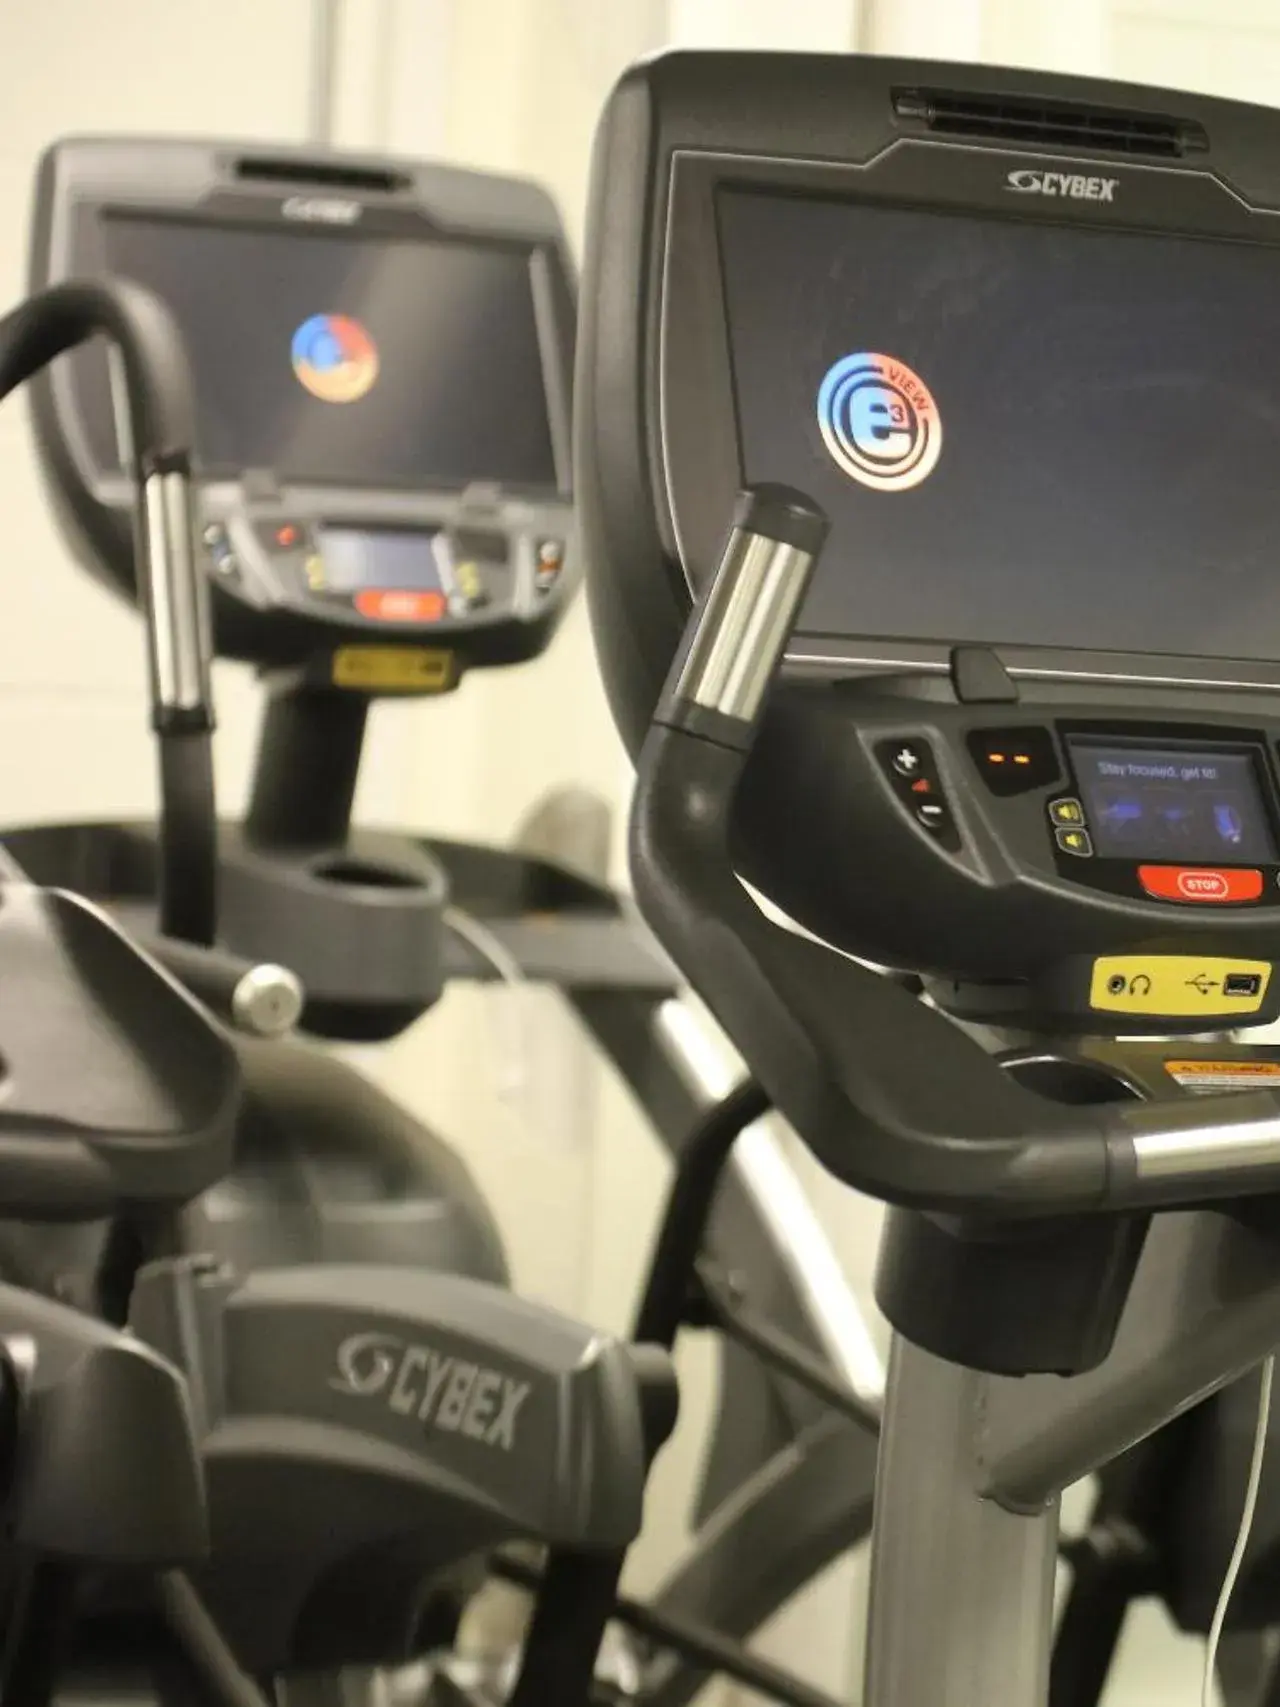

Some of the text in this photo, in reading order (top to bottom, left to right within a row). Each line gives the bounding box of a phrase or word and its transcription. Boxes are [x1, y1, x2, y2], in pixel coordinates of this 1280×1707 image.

[1042, 171, 1113, 201] CYBEX
[889, 366, 929, 411] VIEW
[1187, 879, 1220, 891] STOP
[388, 1345, 531, 1451] CYBEX
